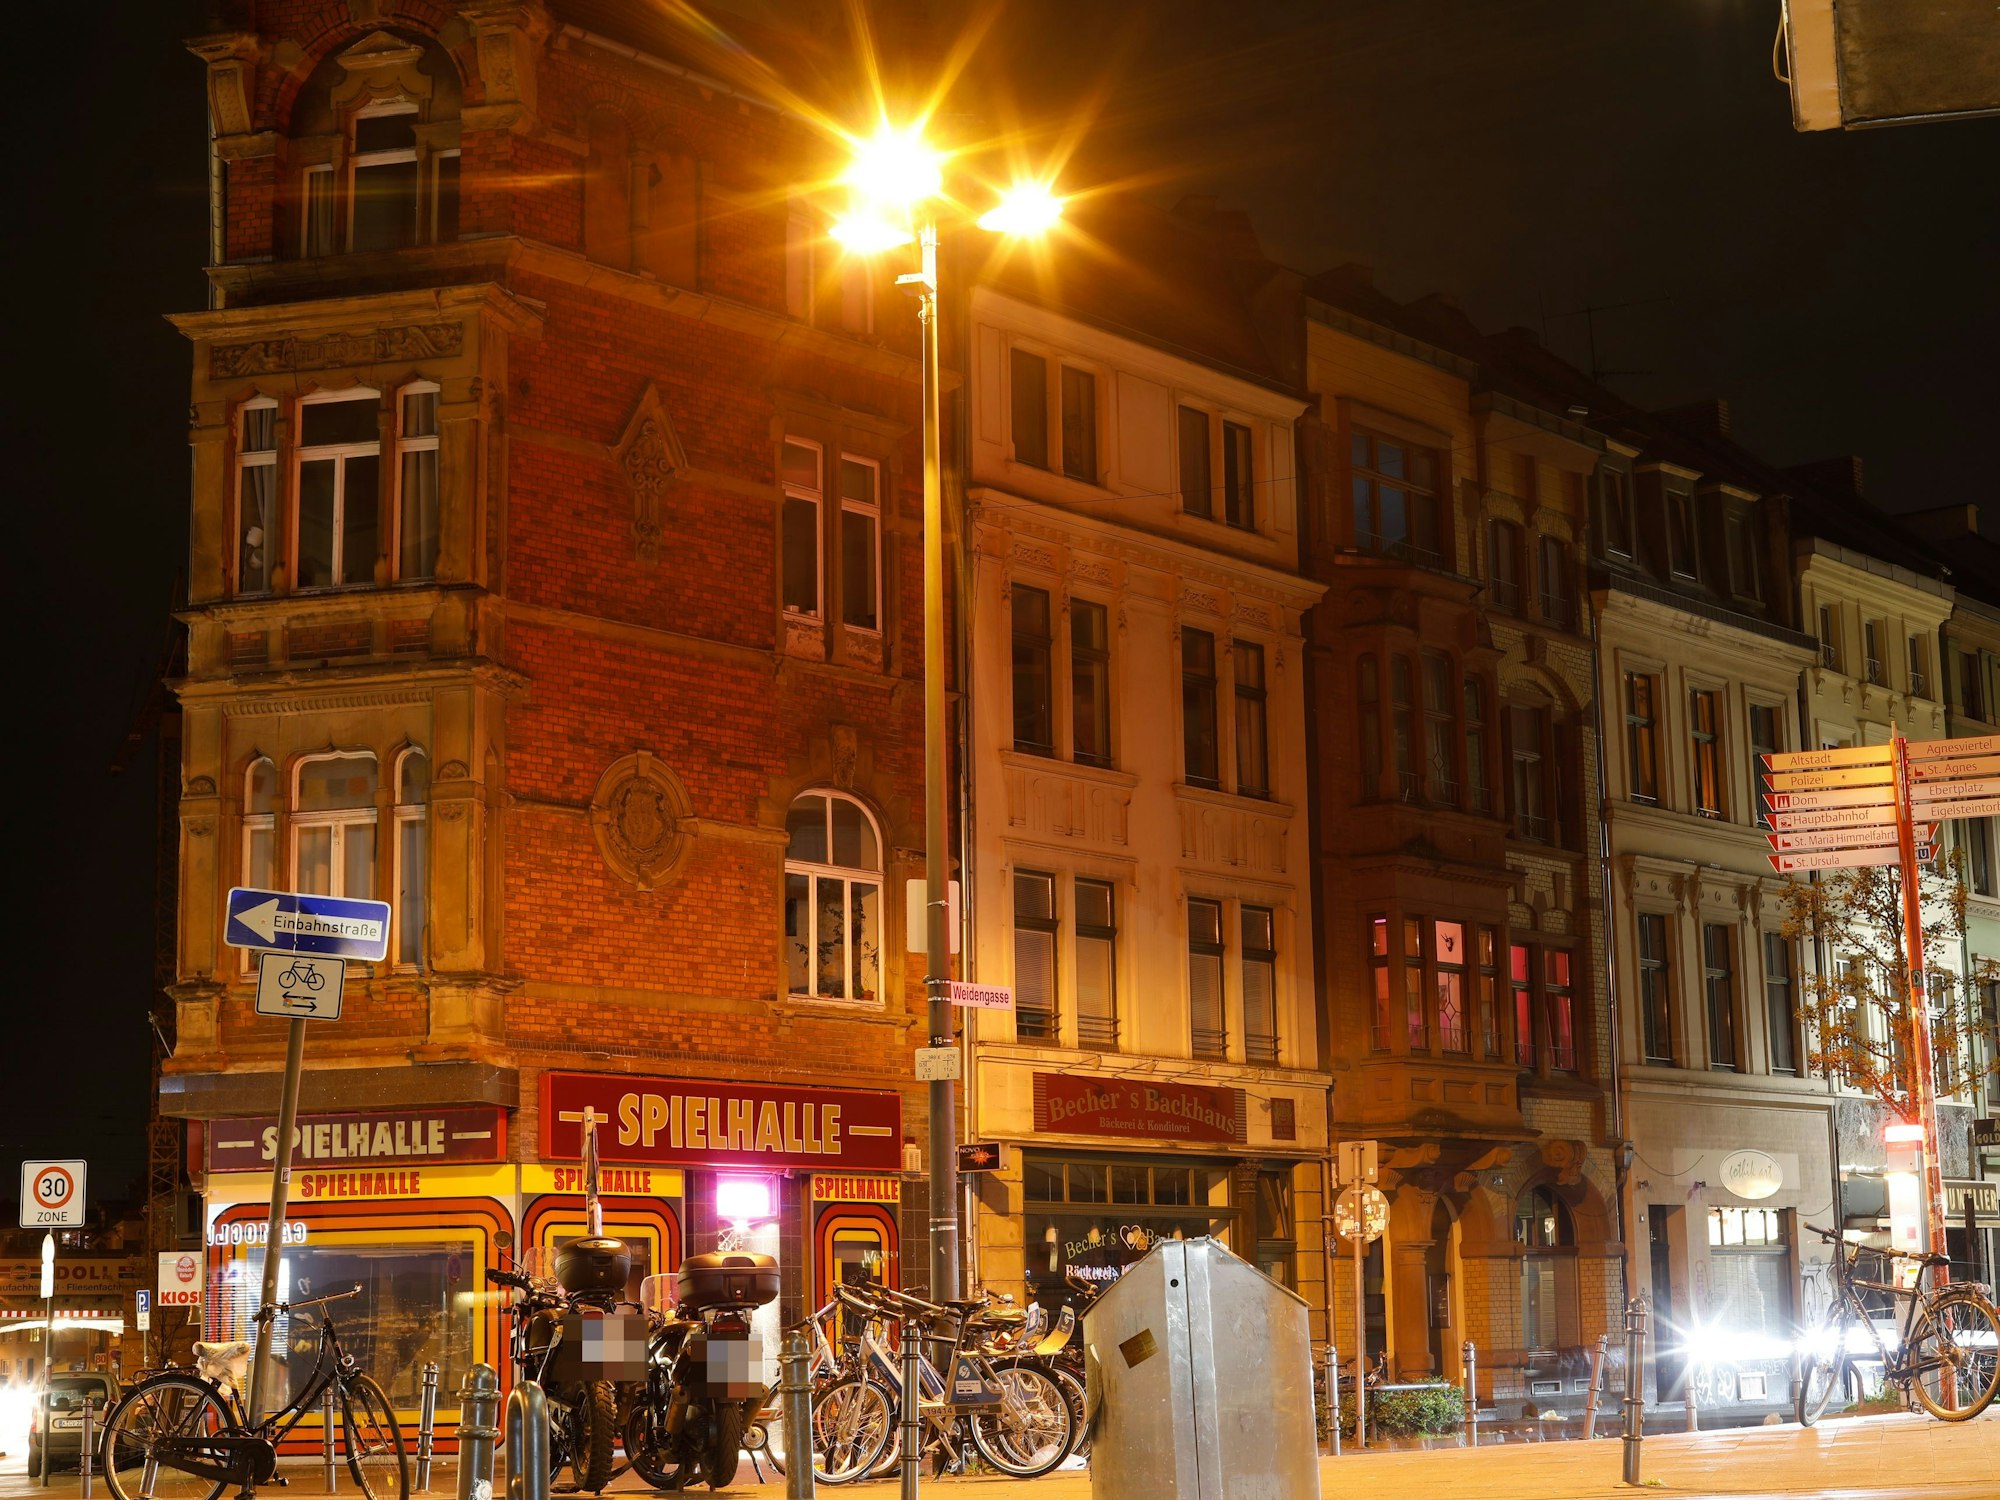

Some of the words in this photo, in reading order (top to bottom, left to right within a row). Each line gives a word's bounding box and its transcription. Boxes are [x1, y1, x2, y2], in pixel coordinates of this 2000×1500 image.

[1926, 739, 1993, 755] Agnesviertel
[1790, 754, 1832, 766] Altstadt
[1928, 765, 1942, 775] St.
[1944, 763, 1978, 774] Agnes
[1790, 774, 1824, 786] Polizei
[1929, 782, 1984, 796] Ebertplatz
[1792, 796, 1818, 806] Dom
[1793, 809, 1870, 826] Hauptbahnhof
[1794, 837, 1807, 847] St.
[1836, 829, 1896, 843] Himmelfahrt
[1796, 858, 1809, 868] St.
[1810, 855, 1840, 867] Ursula
[273, 915, 378, 937] Einbahnstraße
[952, 984, 1010, 1006] Weidengasse
[933, 1036, 943, 1045] 15
[1144, 1088, 1236, 1135] Backhaus
[617, 1092, 842, 1155] SPIELHALLE
[1099, 1115, 1136, 1131] Bäckerei
[1137, 1119, 1145, 1130] &
[1147, 1118, 1191, 1133] Konditorei
[41, 1178, 65, 1197] 30
[301, 1171, 420, 1198] SPIELHALLE
[554, 1167, 651, 1194] SPIHALLE
[815, 1176, 900, 1201] SPIELHALLE
[37, 1211, 68, 1223] ZONE
[137, 1293, 147, 1312] P
[926, 1407, 953, 1416] 19414
